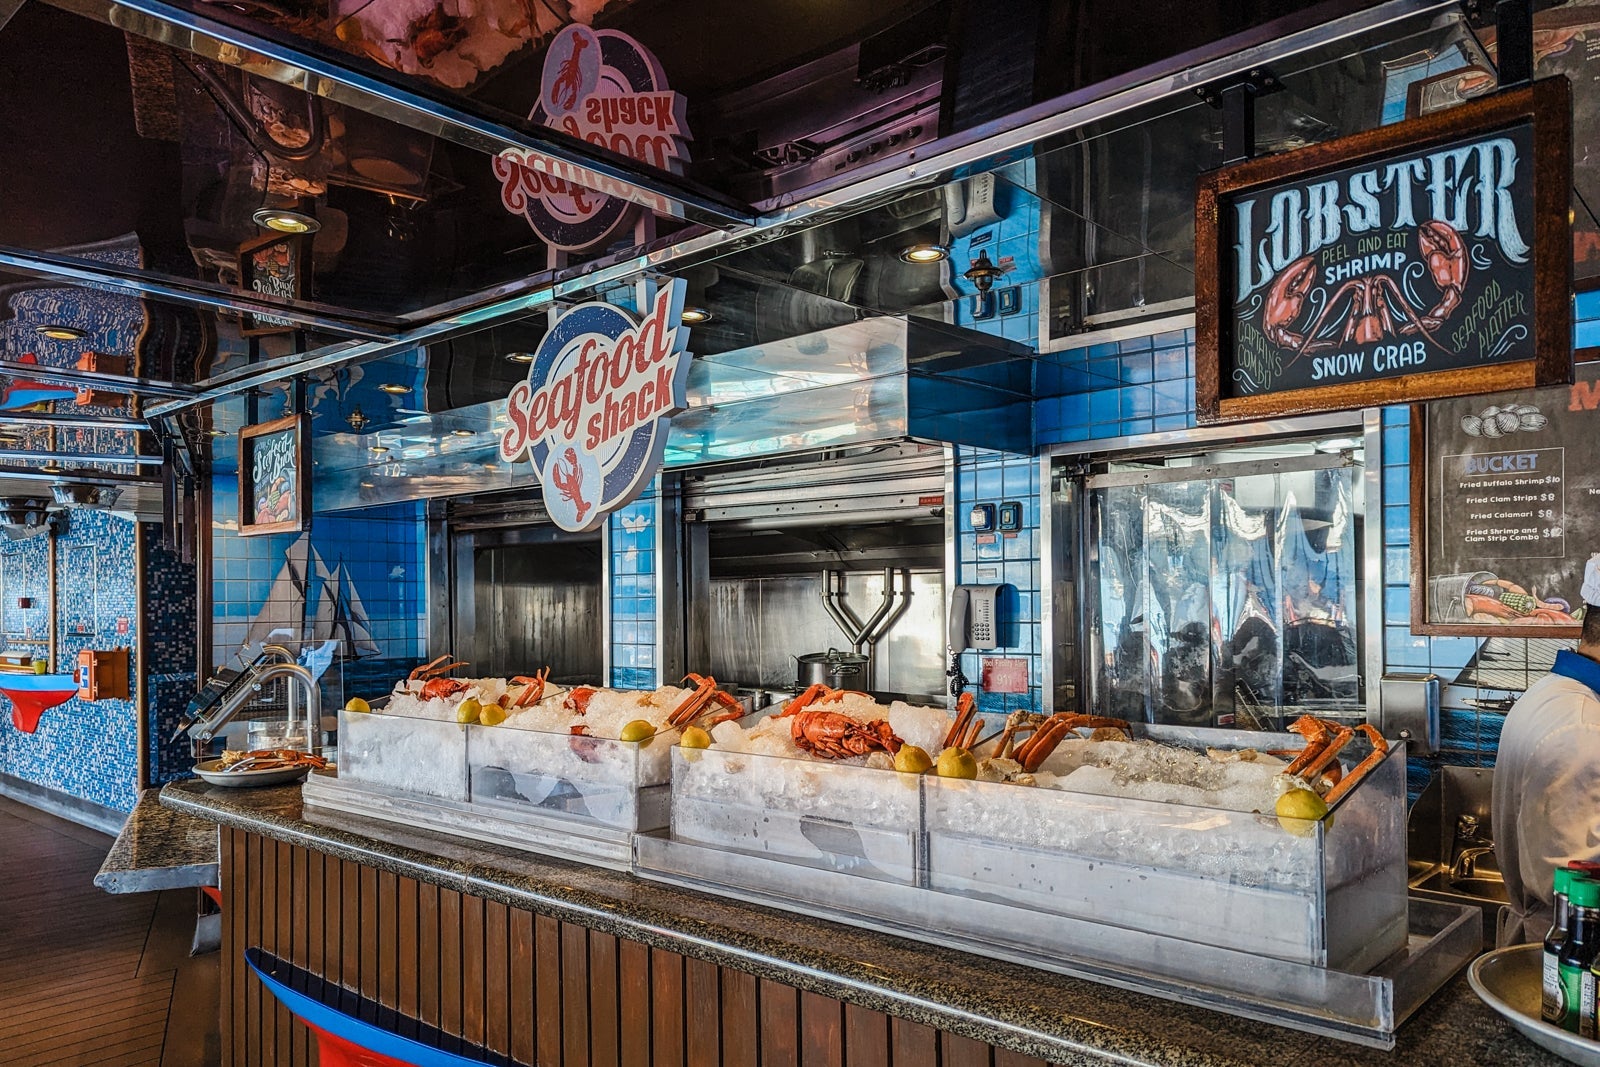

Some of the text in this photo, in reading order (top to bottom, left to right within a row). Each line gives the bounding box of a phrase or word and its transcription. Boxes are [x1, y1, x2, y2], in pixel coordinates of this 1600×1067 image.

[1233, 137, 1531, 304] LOBSTER
[1321, 233, 1409, 267] PEEL AND EAT
[1325, 252, 1407, 285] SHRIMP
[1451, 277, 1501, 353] SEAFOOD
[1478, 289, 1529, 359] PLATTER
[1237, 320, 1282, 377] CAPTAIN'S
[1237, 344, 1272, 390] COMBO
[1311, 341, 1427, 381] SNOW CRAB
[503, 290, 672, 457] Seafood
[586, 364, 673, 451] shack
[1459, 475, 1561, 489] Fried Buffalo Shrimp $10
[1465, 454, 1539, 474] BUCKET
[1466, 496, 1488, 504] Fried
[1490, 495, 1511, 503] Clam
[1513, 494, 1538, 503] Strips
[1470, 512, 1492, 520] Fried
[1494, 511, 1533, 519] Calamari
[1465, 534, 1540, 543] Clam Strip Combo
[1466, 528, 1488, 536] Fried
[1490, 527, 1519, 536] Shrimp
[1521, 527, 1538, 535] and
